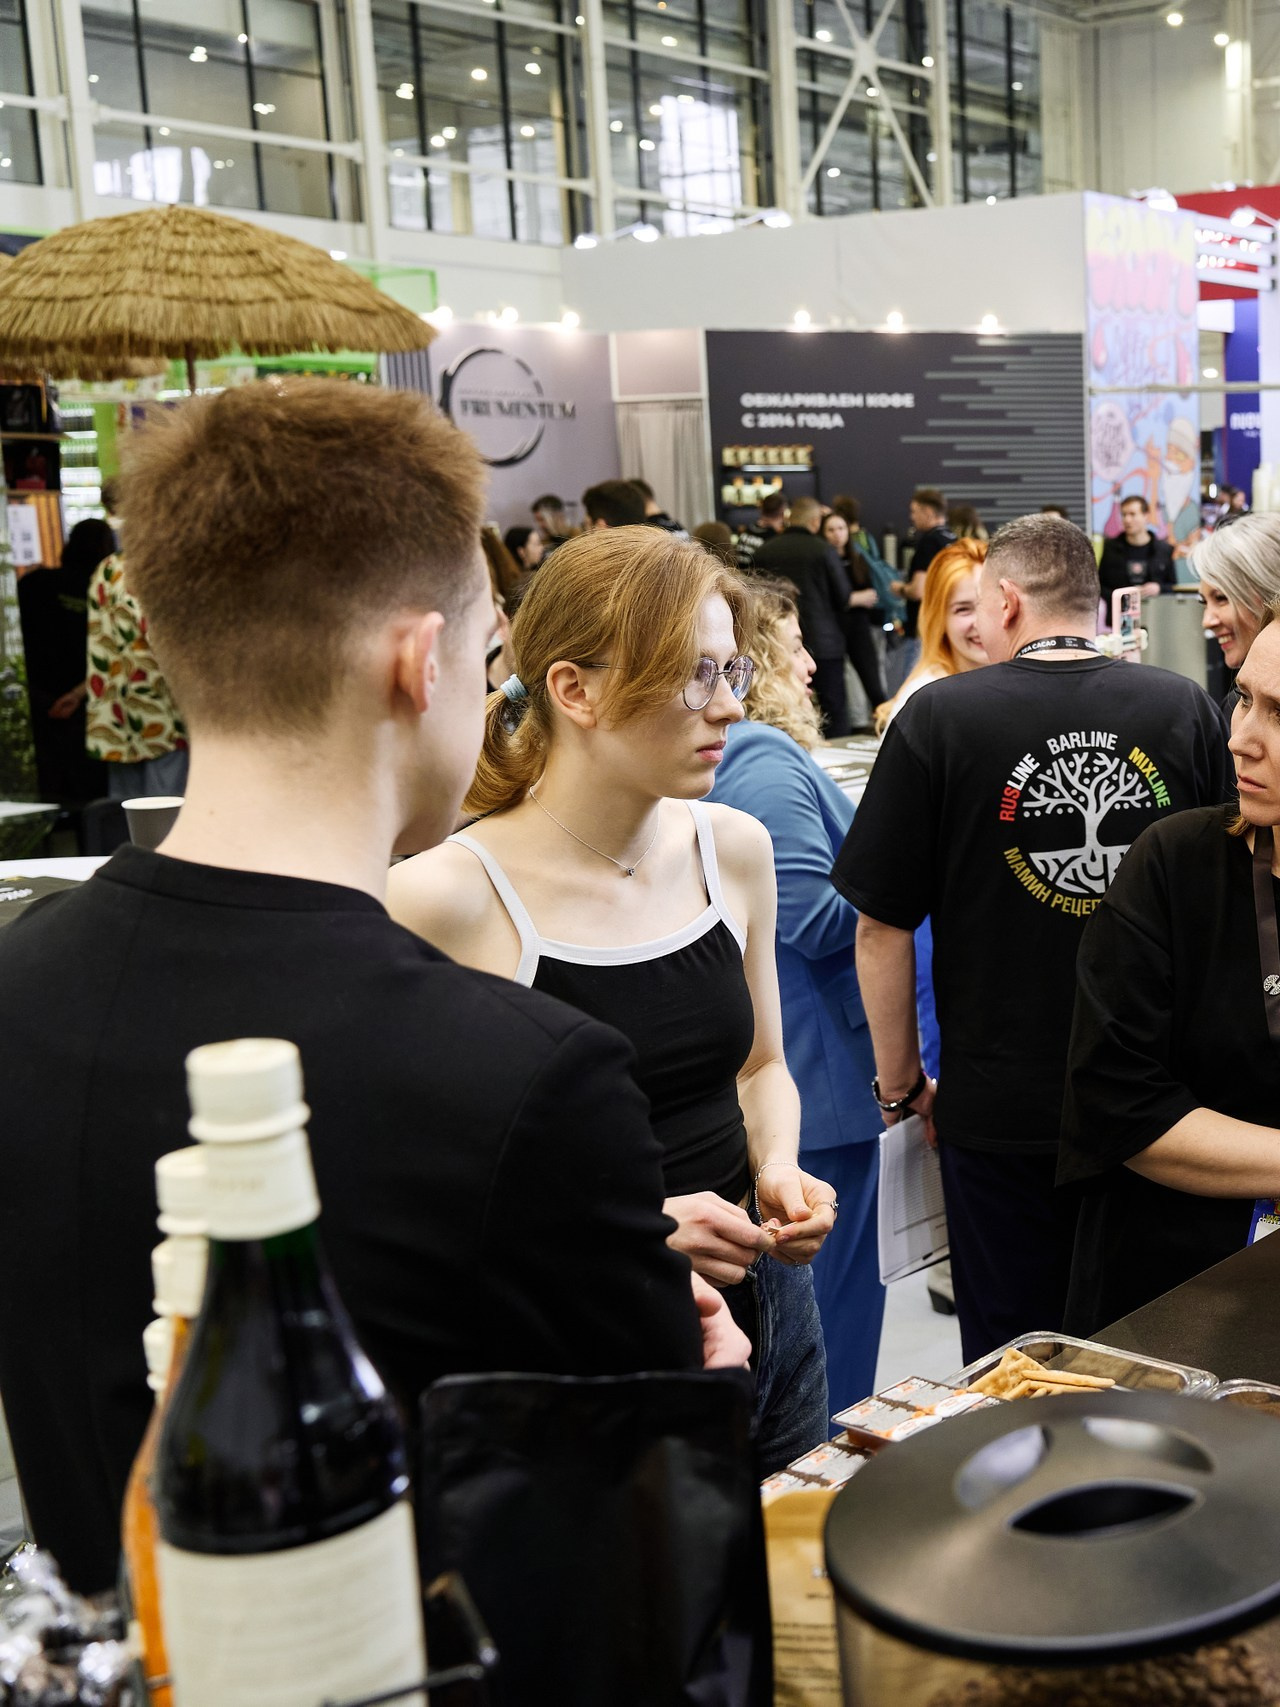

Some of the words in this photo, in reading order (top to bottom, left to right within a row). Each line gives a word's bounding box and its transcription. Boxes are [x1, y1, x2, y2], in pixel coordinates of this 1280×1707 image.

[740, 392, 864, 408] ОБЖАРИВАЕМ
[866, 392, 915, 408] КОФЕ
[741, 413, 755, 428] С
[757, 413, 795, 428] 2014
[797, 413, 845, 430] ГОДА
[1046, 730, 1118, 755] BARLINE
[1000, 752, 1041, 821] RUSLINE
[1128, 746, 1171, 808] MIXLINE
[1004, 846, 1052, 903] МАМИН
